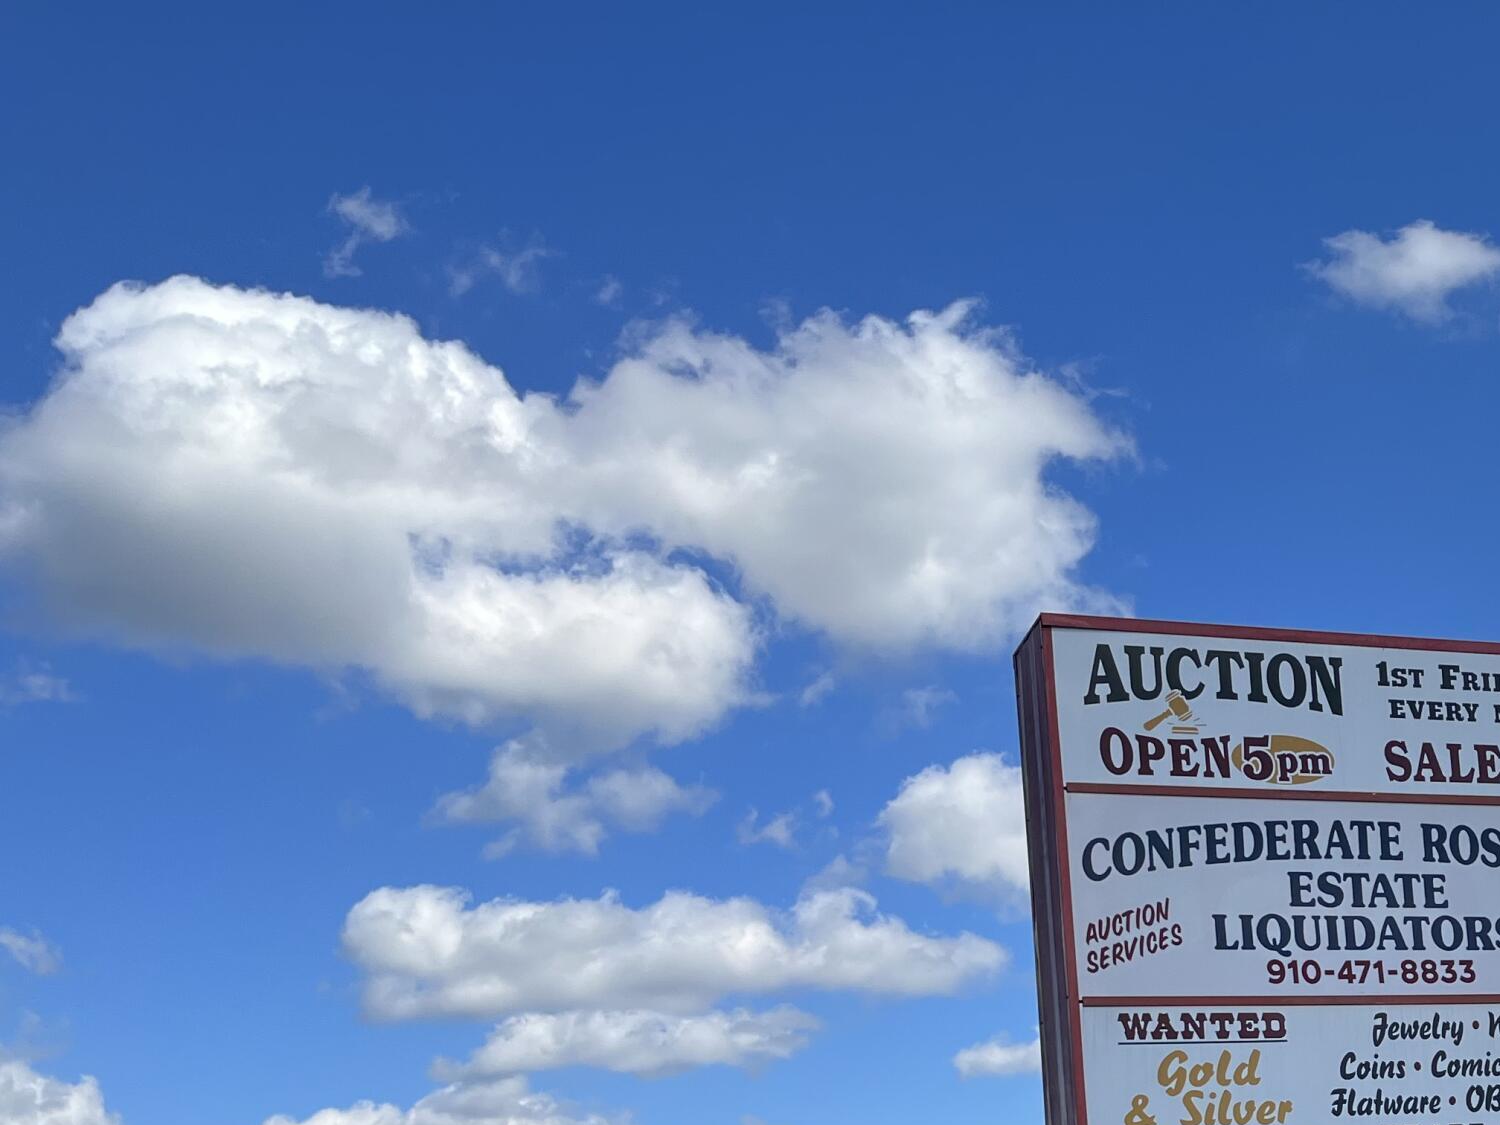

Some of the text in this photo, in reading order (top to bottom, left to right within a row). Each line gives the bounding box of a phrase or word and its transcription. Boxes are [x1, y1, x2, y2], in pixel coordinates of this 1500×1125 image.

[1084, 643, 1343, 716] AUCTION
[1388, 699, 1479, 722] EVERY
[1099, 726, 1333, 782] OPEN 5pm
[1082, 820, 1404, 881] CONFEDERATE
[1287, 871, 1449, 909] ESTATE
[1085, 897, 1170, 945] AUCTION
[1087, 923, 1184, 974] SERVICES
[1266, 959, 1476, 984] 910-471-8833
[1117, 1012, 1288, 1040] WANTED
[1372, 1011, 1464, 1047] Jewelry
[1157, 1049, 1261, 1097] Gold
[1339, 1052, 1406, 1080] Coins
[1331, 1088, 1441, 1117] Flatware
